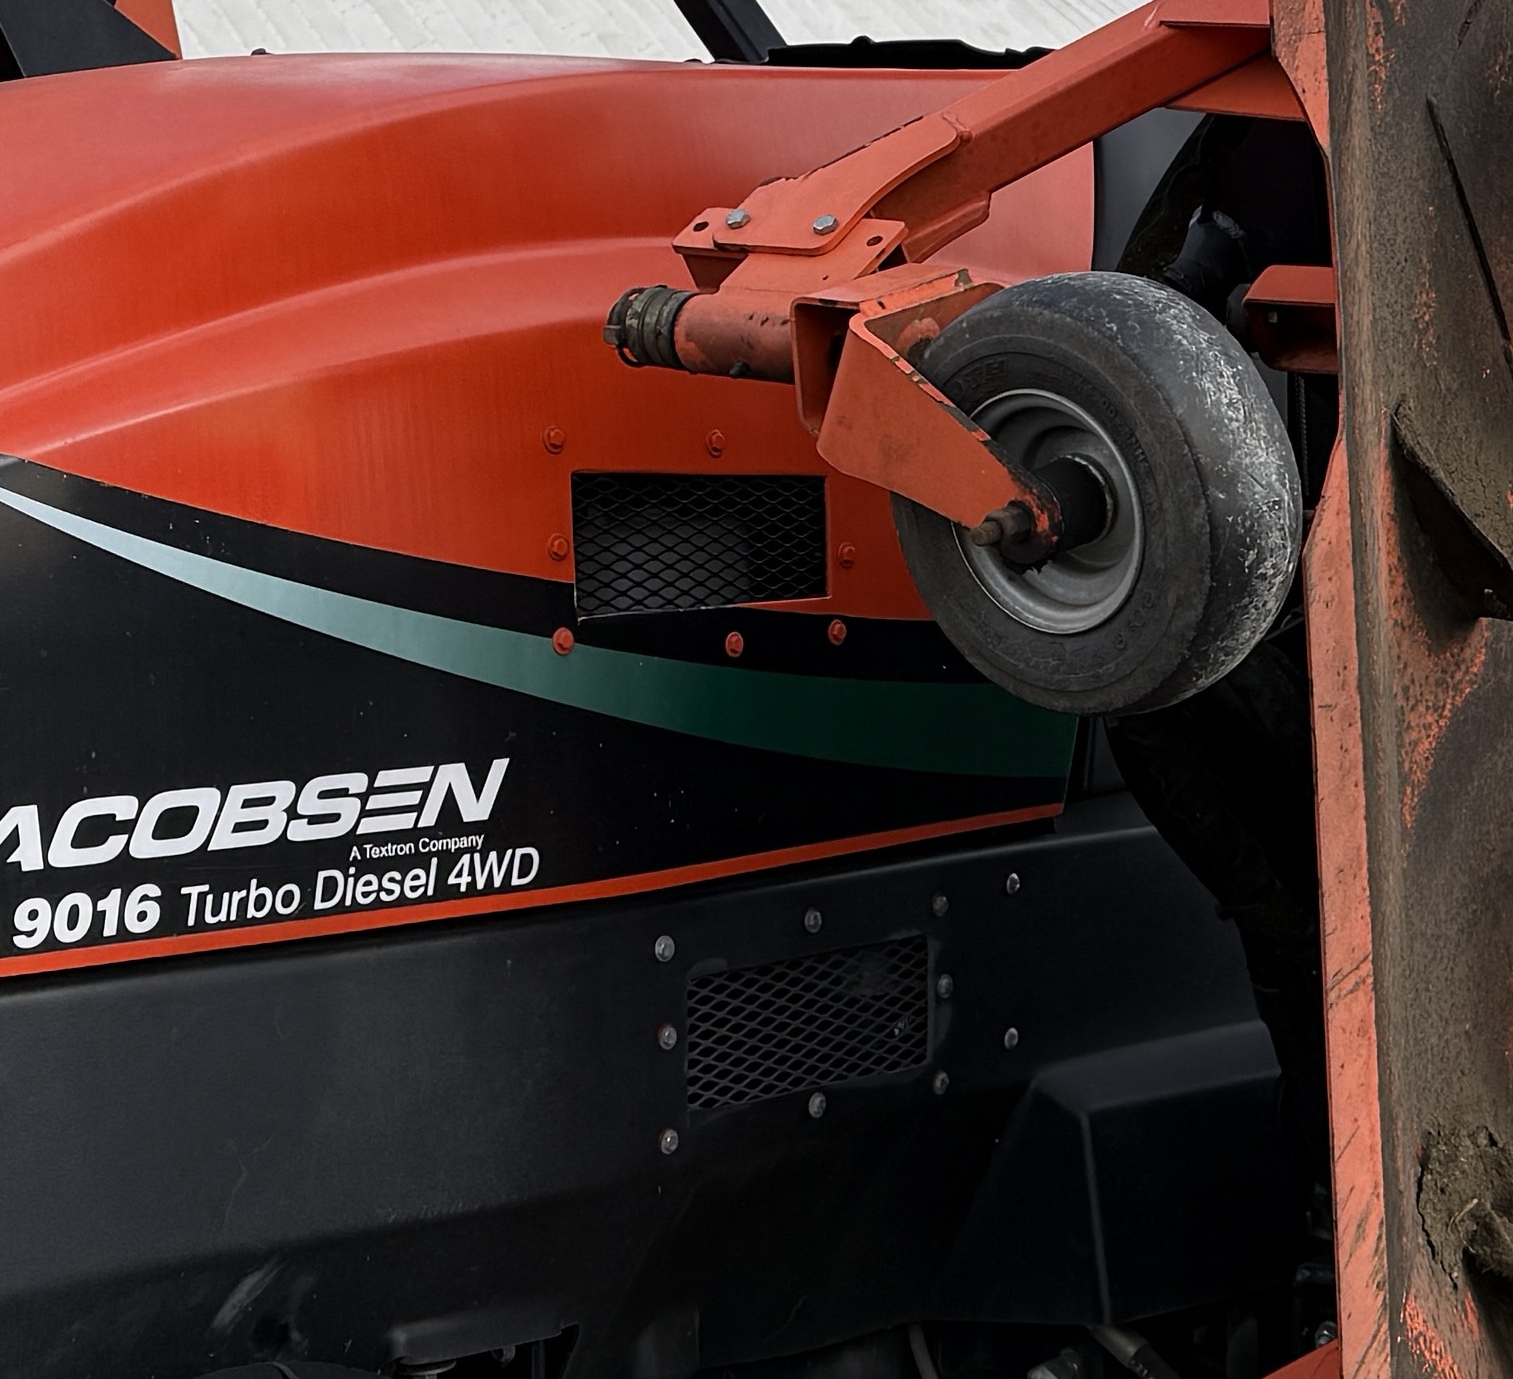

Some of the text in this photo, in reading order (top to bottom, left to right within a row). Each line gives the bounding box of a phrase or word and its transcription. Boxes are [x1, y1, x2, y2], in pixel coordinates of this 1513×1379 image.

[350, 833, 485, 861] A Textron Company
[12, 883, 162, 950] 9016
[180, 877, 301, 929] Turbo
[314, 858, 436, 911] Diesel
[446, 847, 541, 893] 4WD
